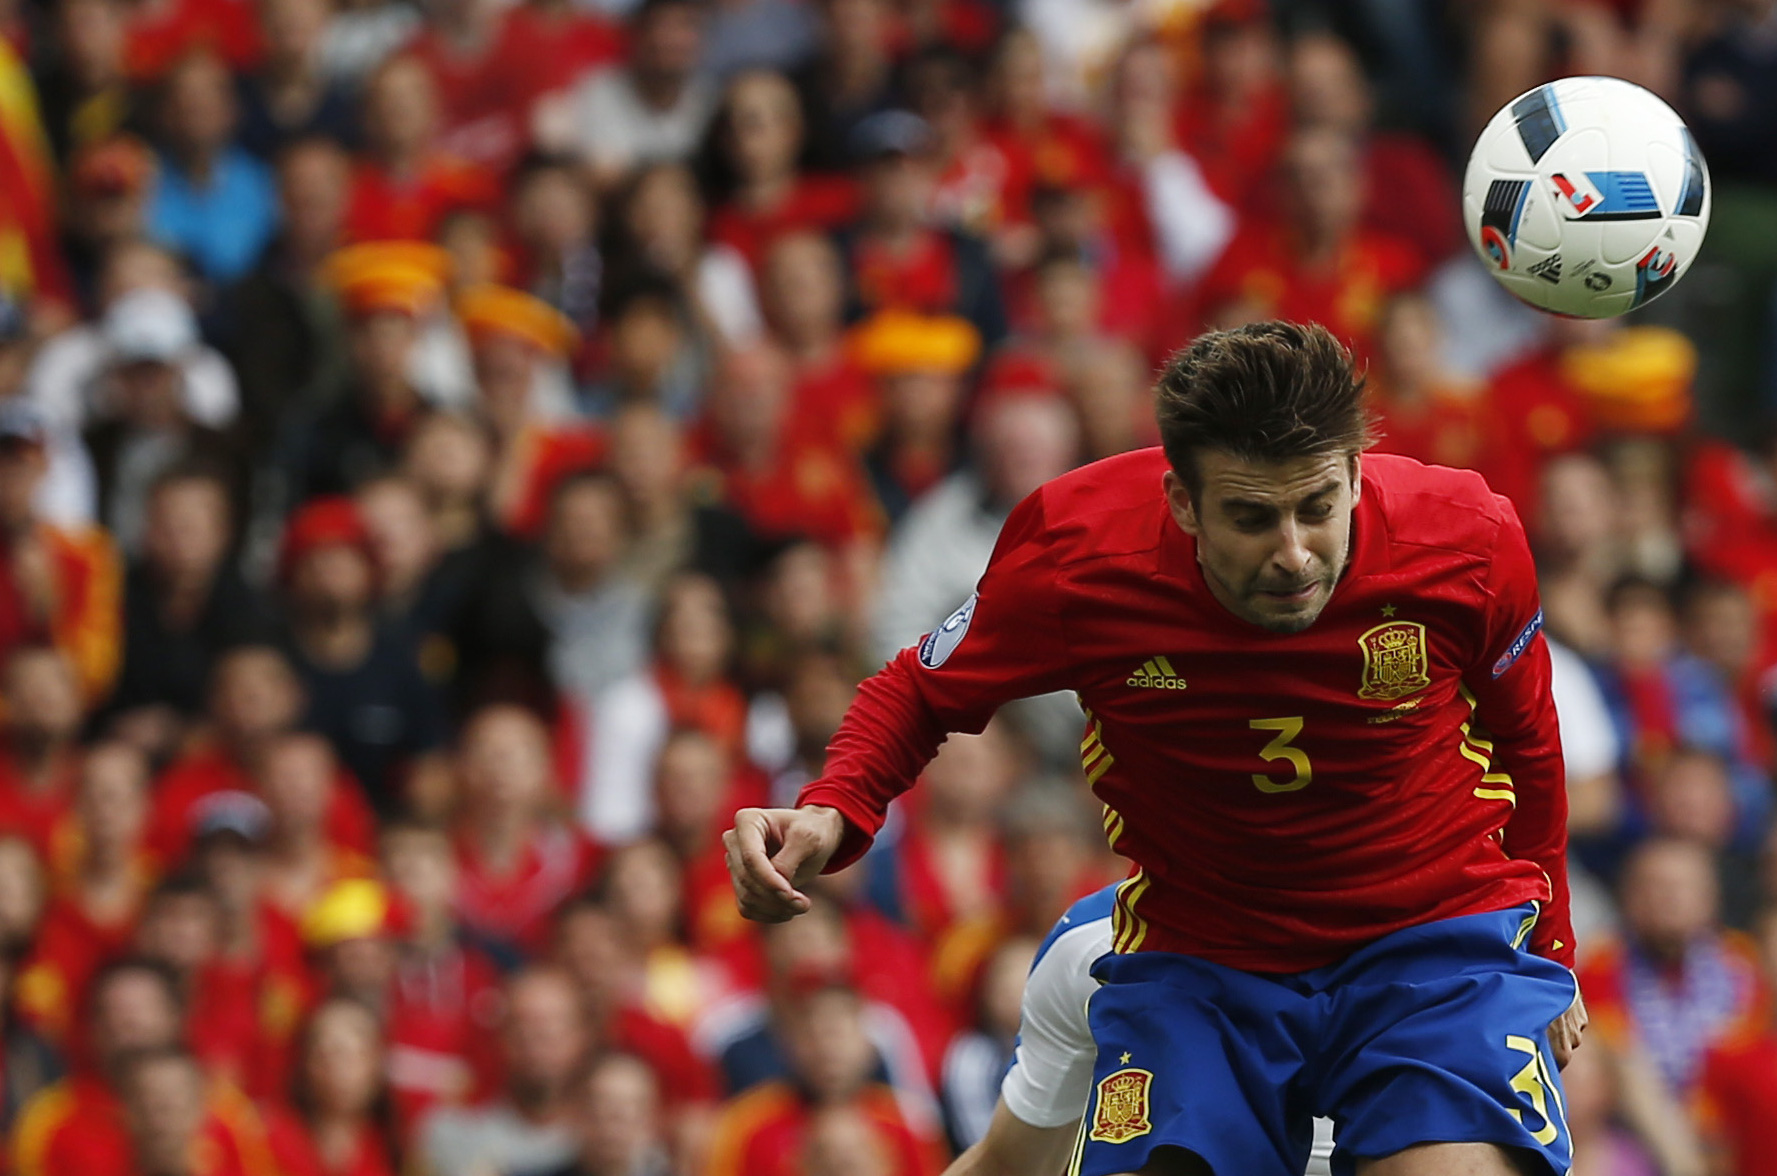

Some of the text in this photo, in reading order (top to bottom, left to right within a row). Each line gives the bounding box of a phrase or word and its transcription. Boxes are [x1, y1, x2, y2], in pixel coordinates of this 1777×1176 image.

[1126, 675, 1187, 690] adidas
[1248, 715, 1313, 794] 3
[1505, 1034, 1559, 1147] 3
